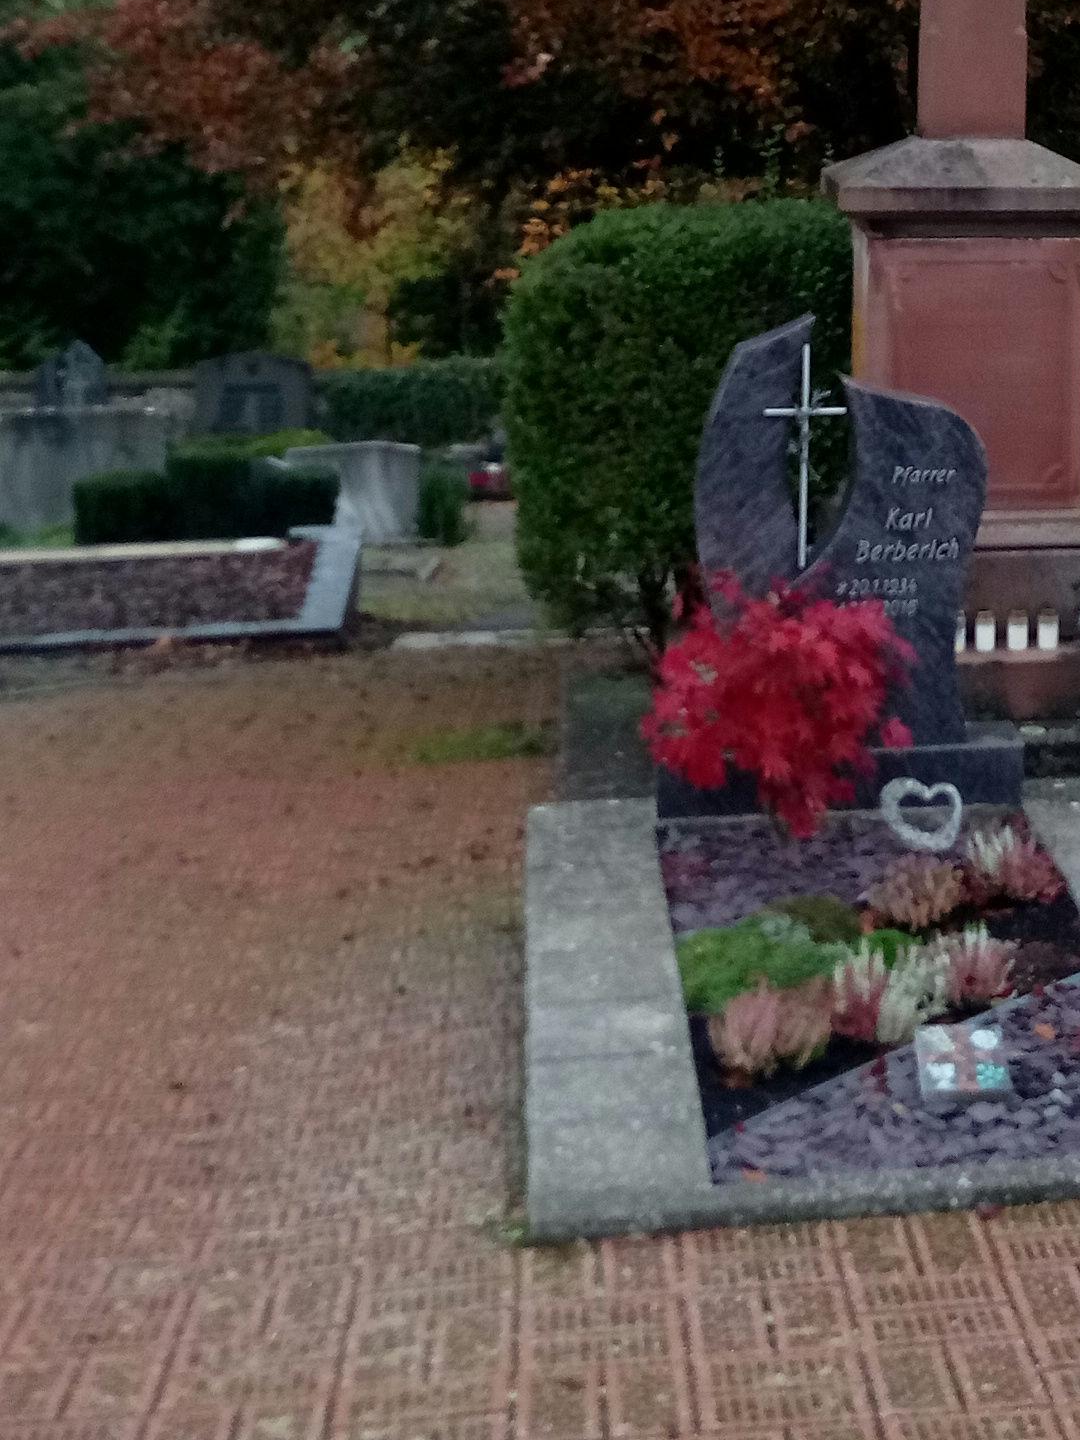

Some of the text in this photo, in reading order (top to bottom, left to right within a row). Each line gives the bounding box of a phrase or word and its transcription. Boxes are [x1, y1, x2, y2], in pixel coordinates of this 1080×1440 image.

[891, 465, 957, 486] Pfarrer
[884, 507, 932, 530] Karl
[856, 537, 960, 561] Berberich
